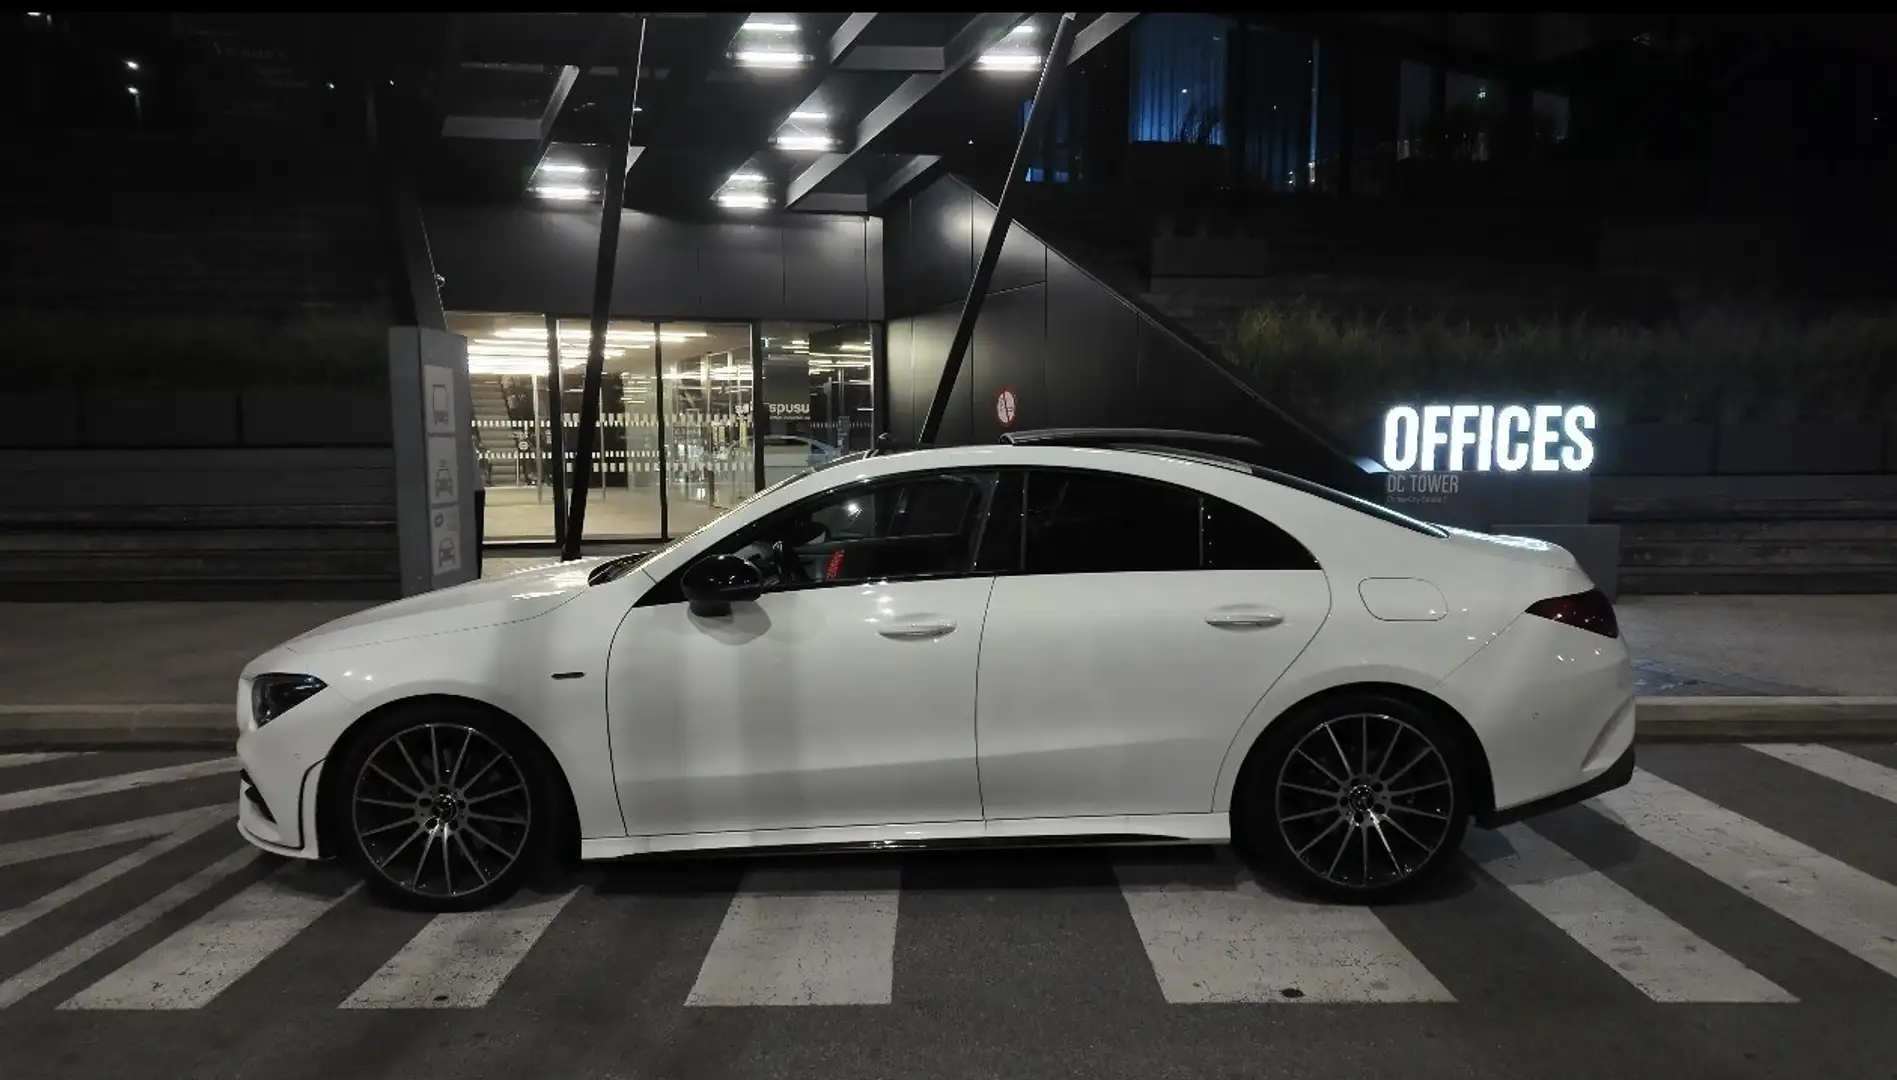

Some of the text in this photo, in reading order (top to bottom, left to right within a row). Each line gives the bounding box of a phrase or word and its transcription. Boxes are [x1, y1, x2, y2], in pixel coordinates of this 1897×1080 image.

[769, 404, 810, 416] spusu
[1383, 404, 1596, 473] OFFICES
[1387, 475, 1459, 494] DC TOWER
